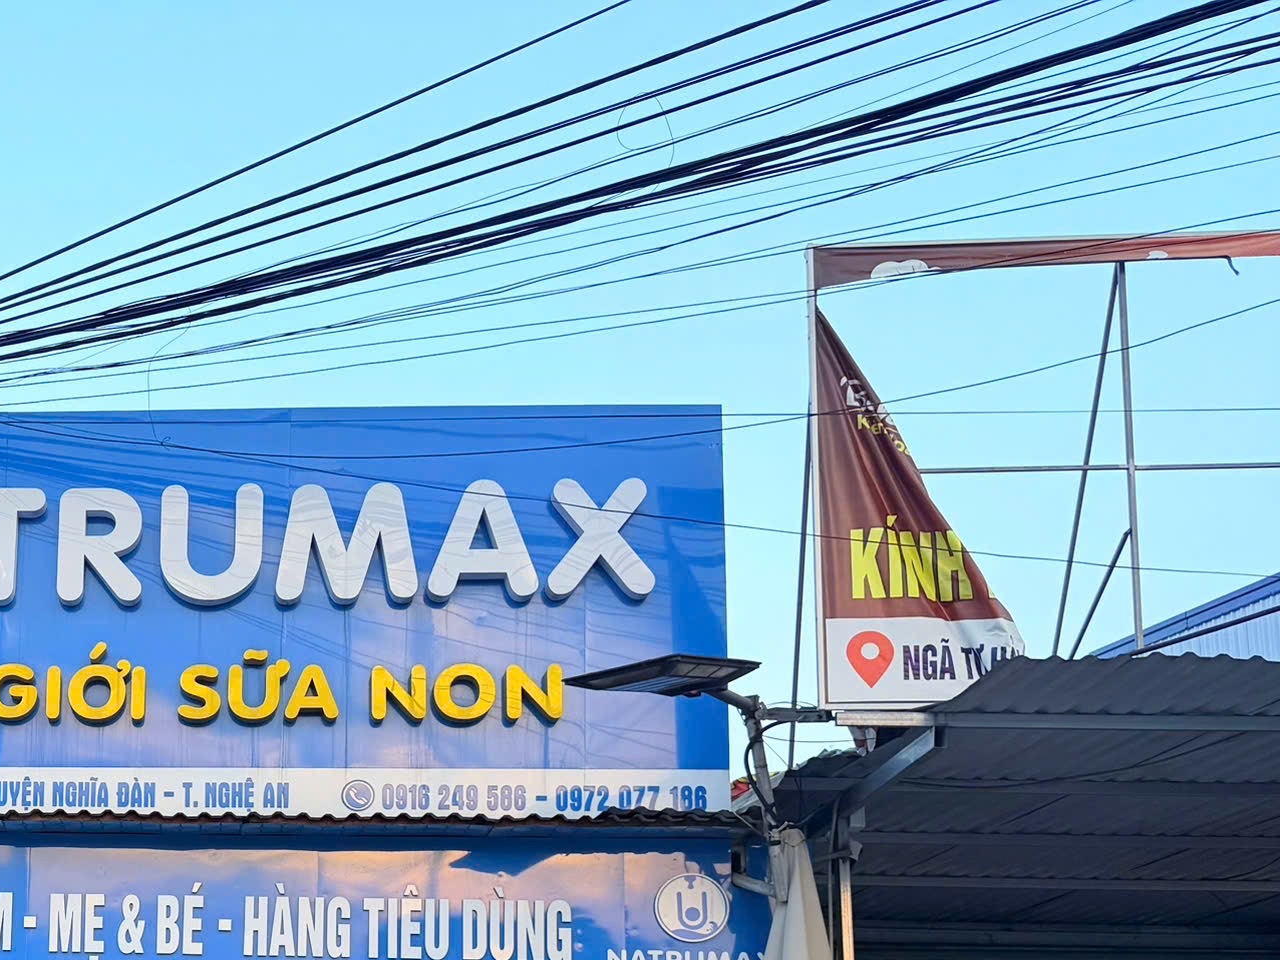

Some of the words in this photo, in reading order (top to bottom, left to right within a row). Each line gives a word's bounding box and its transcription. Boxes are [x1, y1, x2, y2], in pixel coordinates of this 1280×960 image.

[850, 515, 973, 602] KÍNH
[177, 650, 339, 723] SỮA
[370, 663, 564, 722] NON
[902, 638, 956, 681] NGÃ
[52, 777, 108, 808] NGHĨA
[117, 777, 155, 808] ĐÀN
[183, 782, 198, 808] T.
[205, 778, 255, 812] NGHỆ
[263, 782, 289, 808] AN
[382, 784, 430, 810] 0916
[438, 785, 478, 811] 249
[487, 785, 526, 811] 586
[556, 786, 609, 811] 0972
[619, 786, 659, 809] 077
[670, 786, 707, 811] 186
[119, 895, 145, 954] &
[156, 882, 204, 955] BÉ
[243, 883, 351, 958] HÀNG
[363, 885, 449, 960] TIÊU
